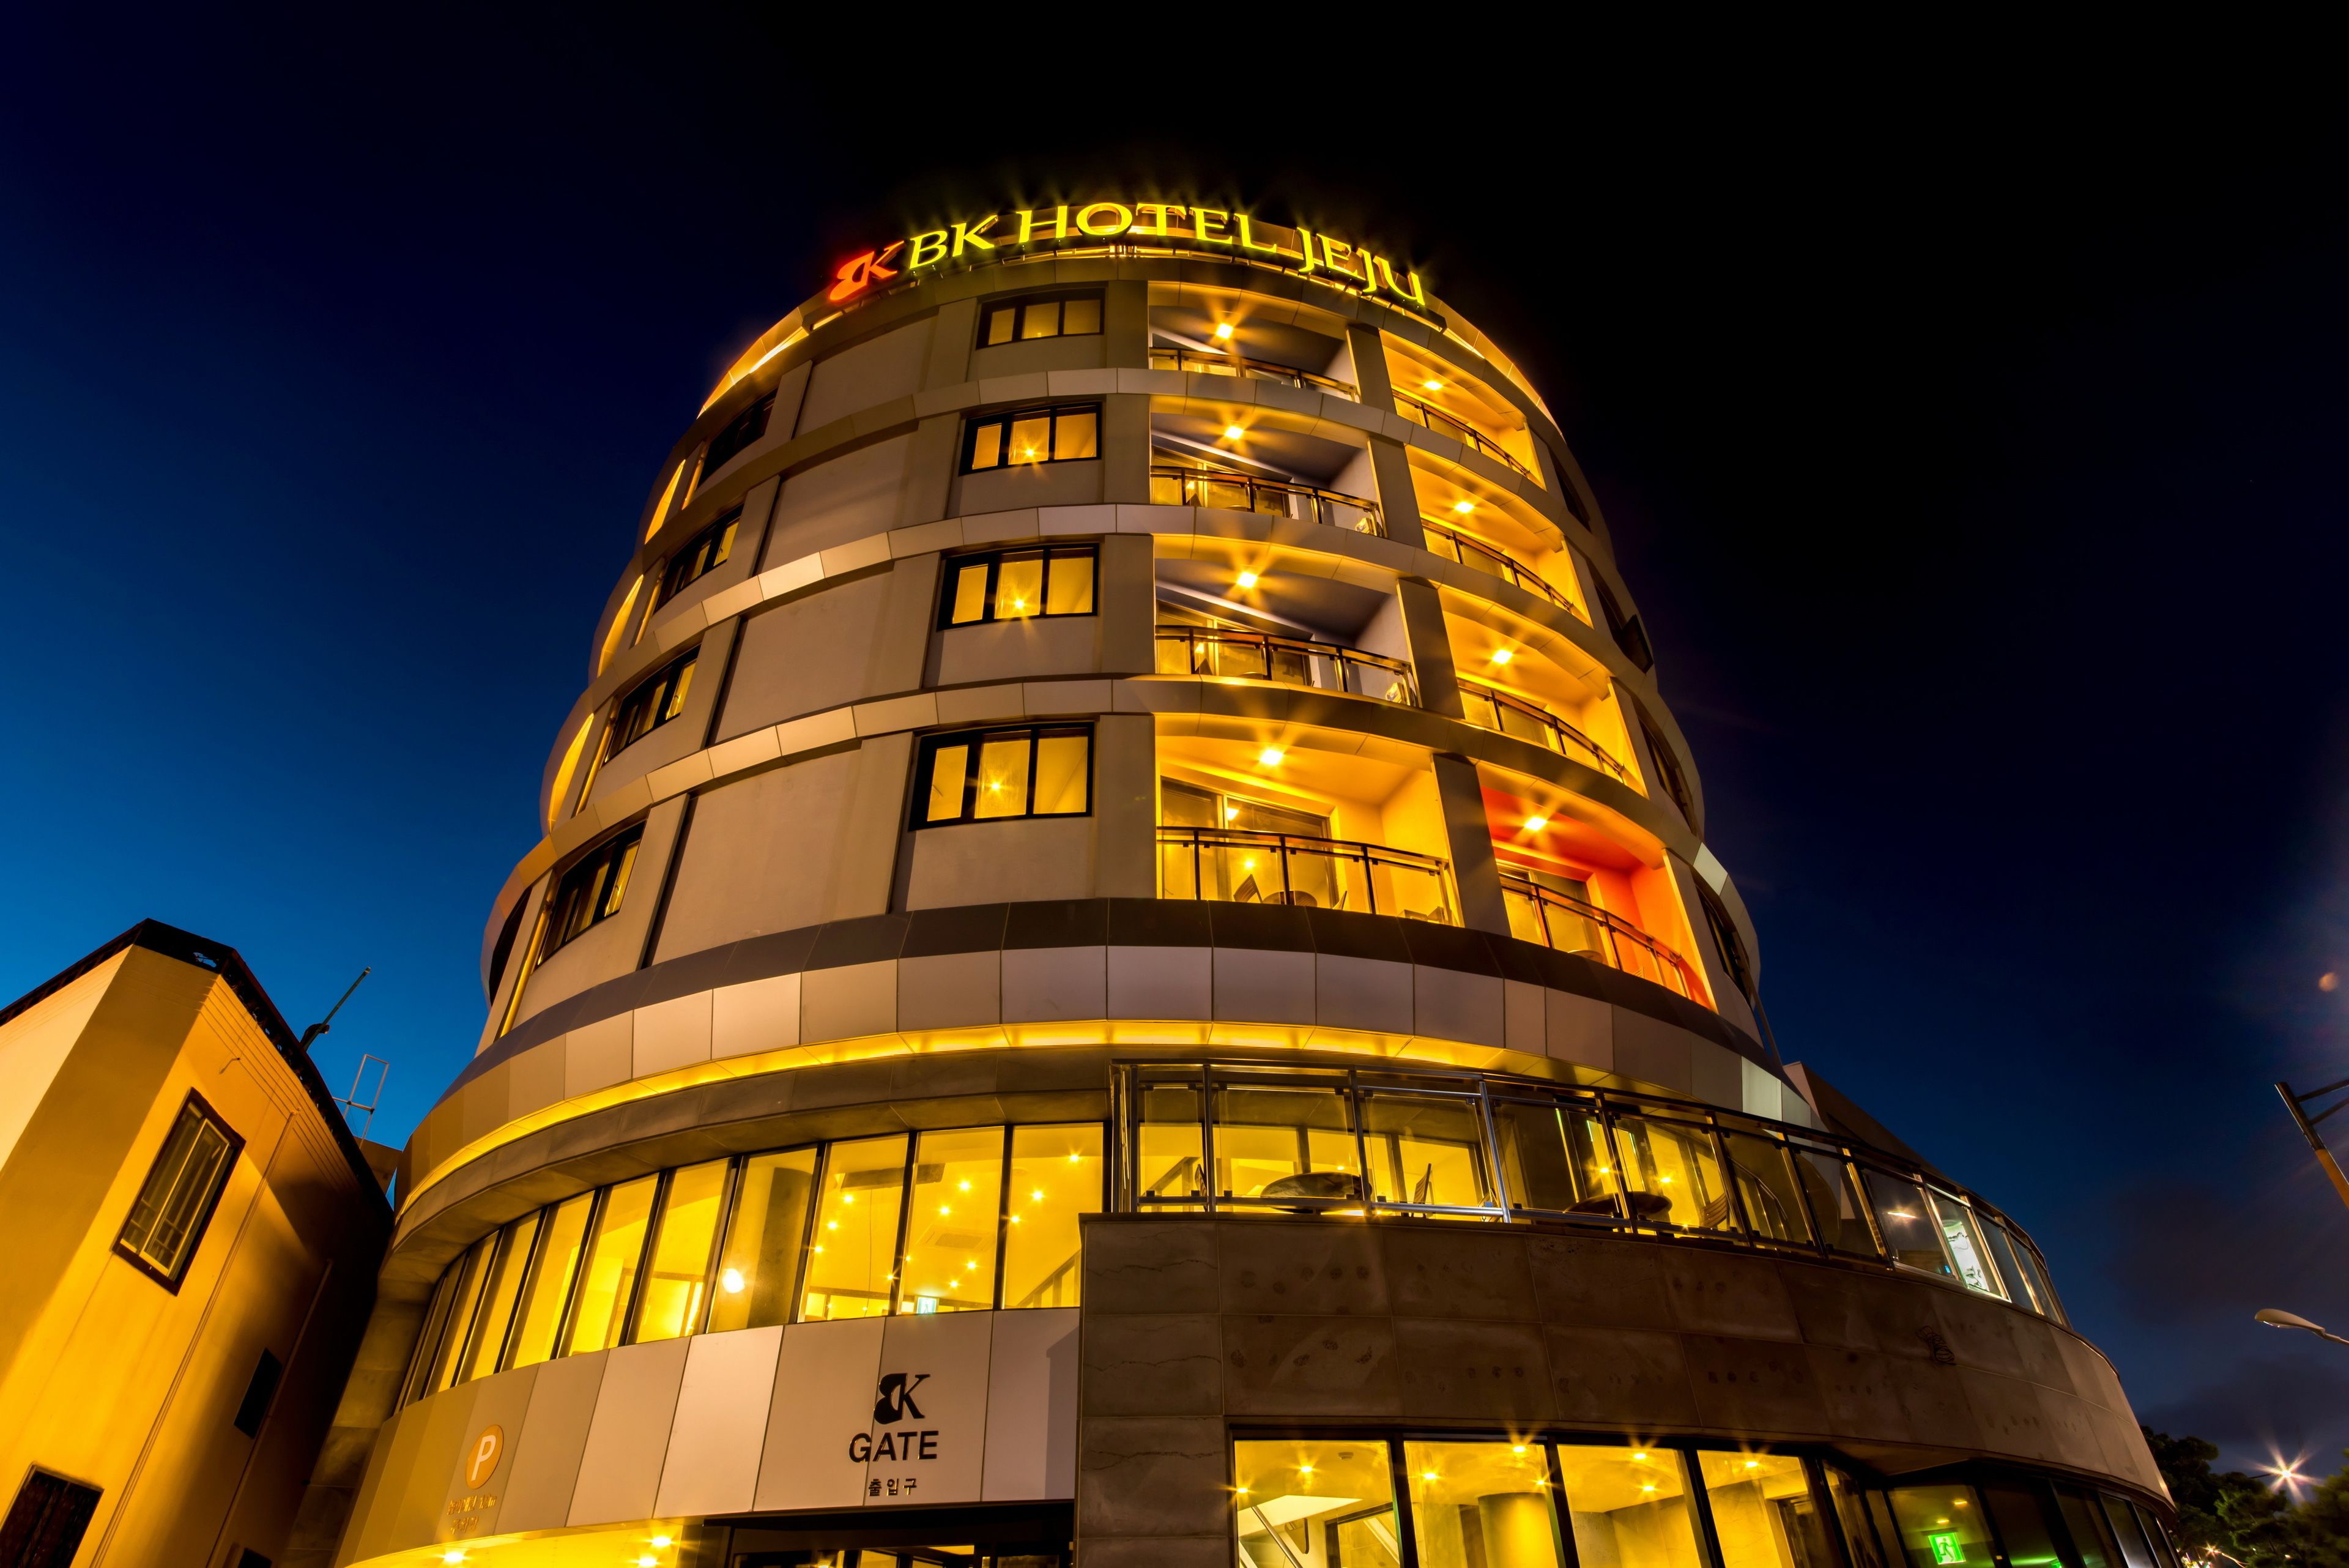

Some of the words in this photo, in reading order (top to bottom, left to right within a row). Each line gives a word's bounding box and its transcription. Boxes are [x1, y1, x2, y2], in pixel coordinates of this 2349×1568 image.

[909, 214, 998, 269] BK
[1015, 203, 1277, 253] HOTEL
[1296, 226, 1425, 306] JEJU
[471, 1435, 496, 1482] P
[848, 1430, 939, 1463] GATE
[868, 1478, 917, 1496] 출입구
